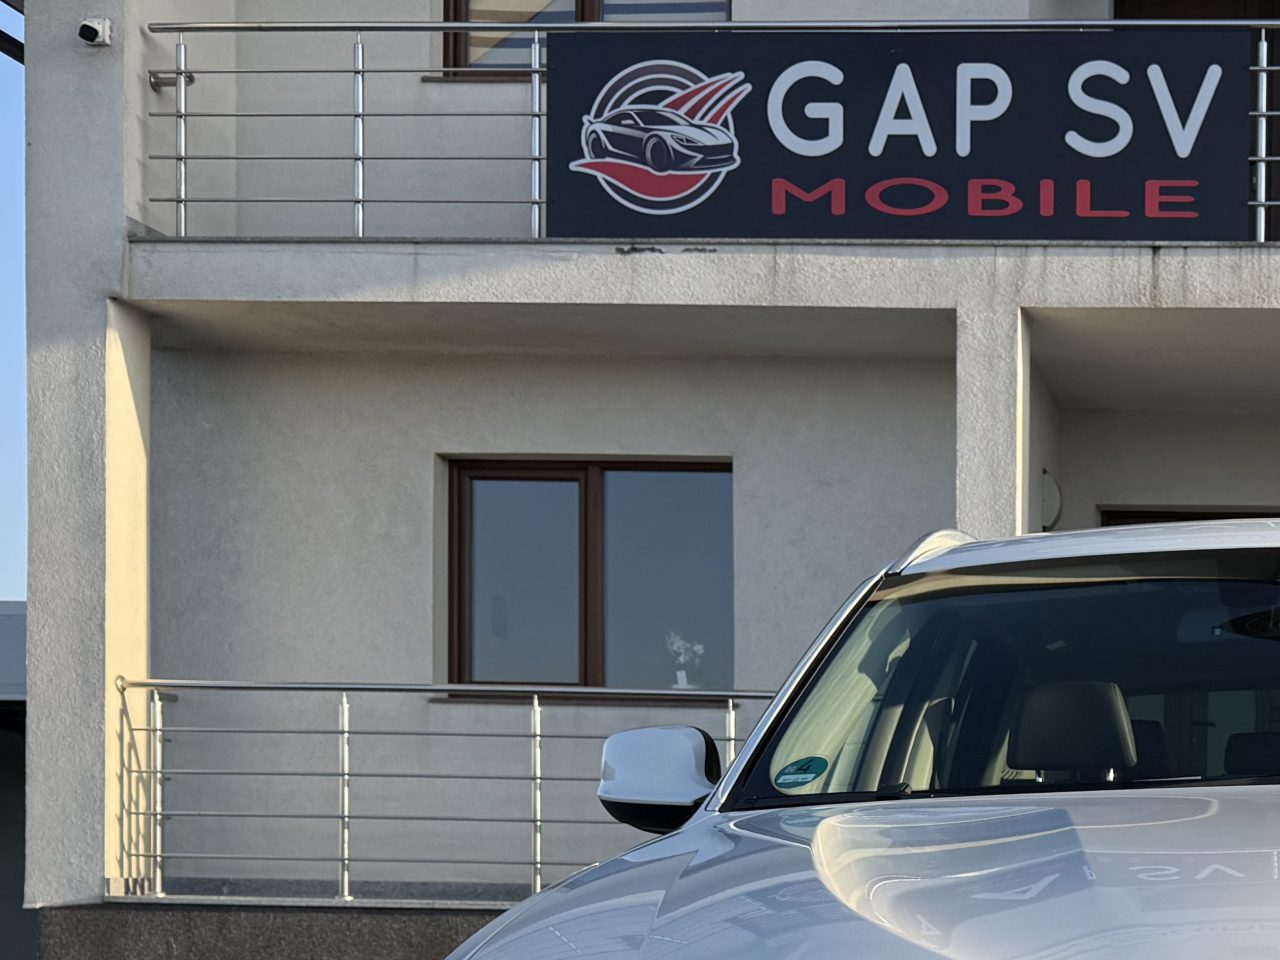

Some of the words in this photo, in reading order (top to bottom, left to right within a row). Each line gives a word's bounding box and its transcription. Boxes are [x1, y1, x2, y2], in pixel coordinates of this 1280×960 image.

[767, 60, 1013, 158] GAP
[1064, 60, 1223, 158] SV
[771, 177, 1200, 218] MOBILE
[796, 758, 815, 773] 4
